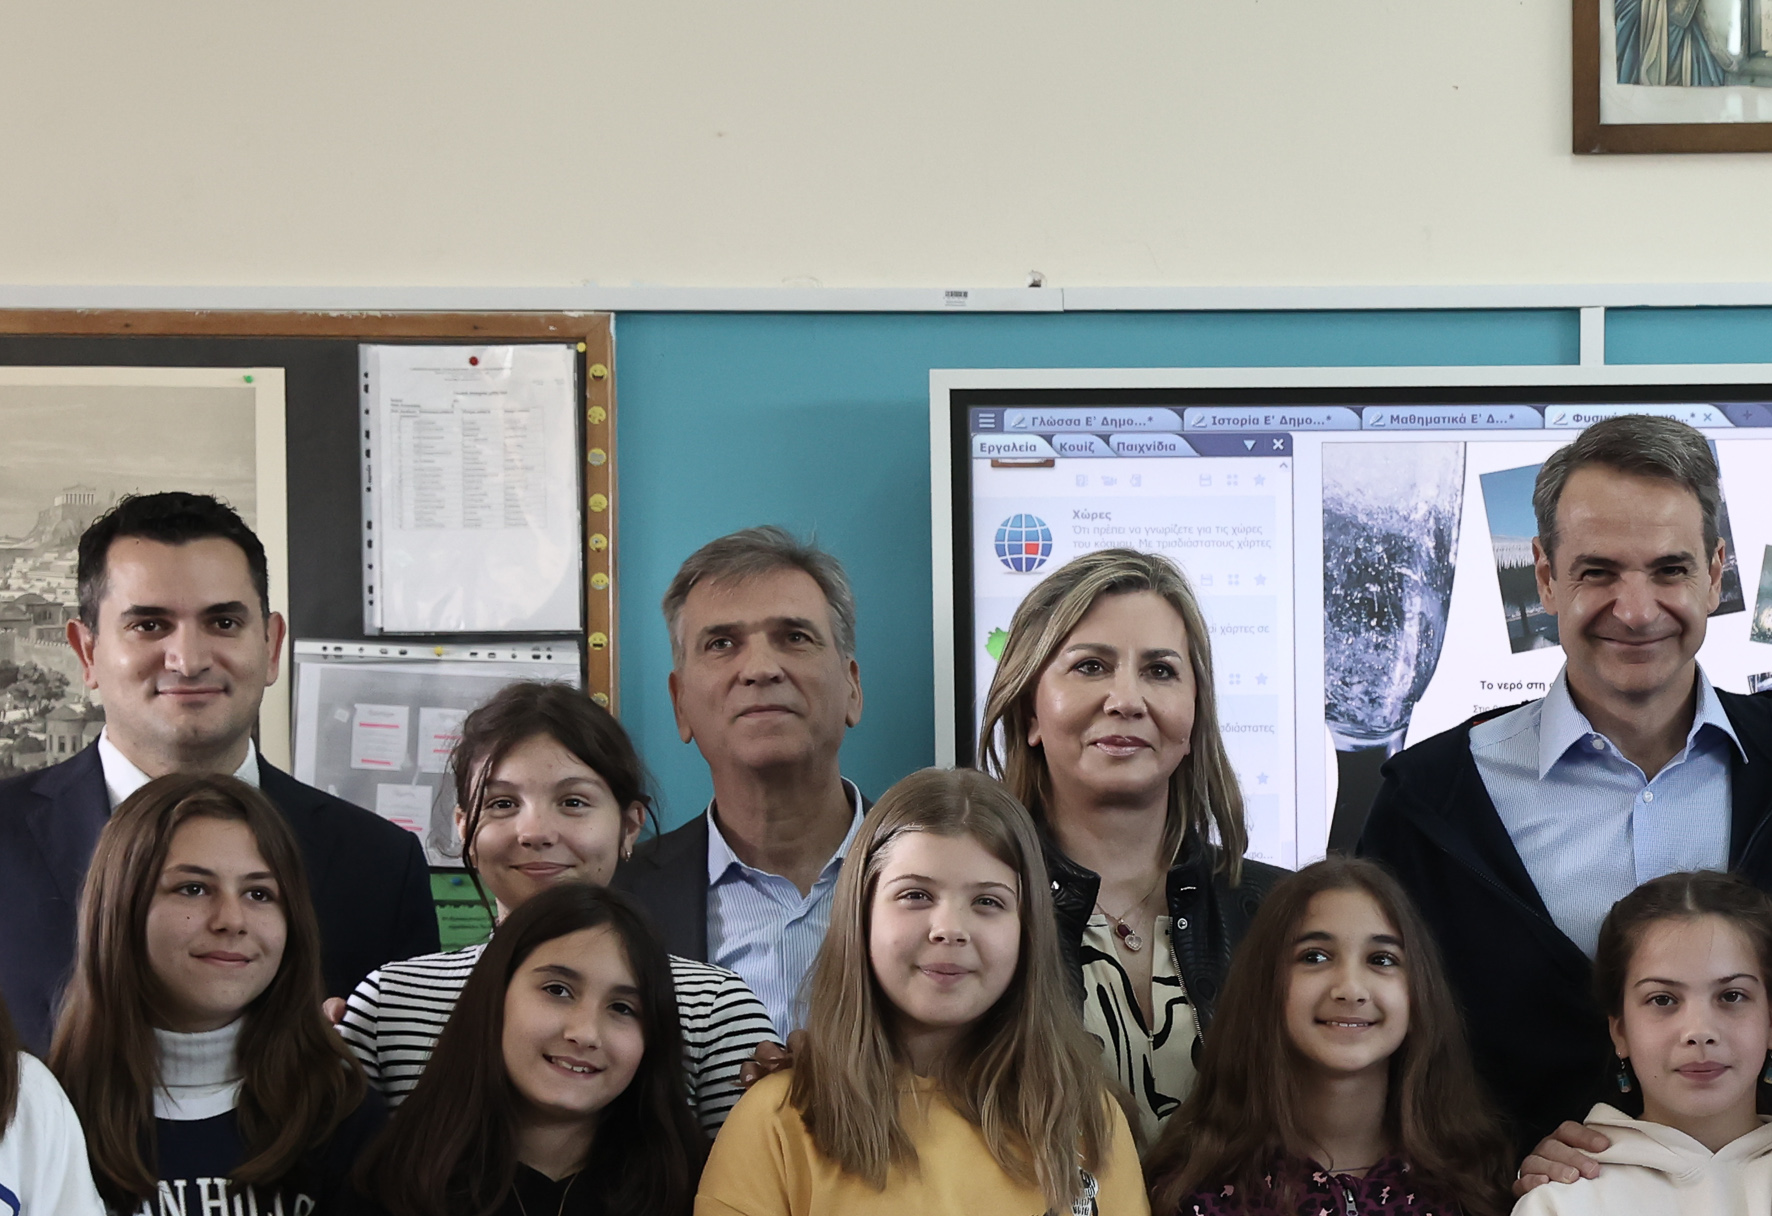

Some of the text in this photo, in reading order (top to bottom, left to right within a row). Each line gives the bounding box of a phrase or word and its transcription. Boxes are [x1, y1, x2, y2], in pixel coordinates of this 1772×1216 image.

[1031, 415, 1081, 427] Γλώσσα
[1211, 414, 1260, 428] Ιστορία
[1390, 413, 1467, 427] Μαθηματικά
[979, 441, 1176, 455] Εργαλεία Κουίζ Παιχνίδια
[1072, 508, 1112, 521] Χώρες
[1093, 525, 1126, 537] πρέπει
[1130, 526, 1142, 535] να
[1144, 524, 1194, 537] γνωρίζετε
[1196, 526, 1212, 536] για
[1215, 526, 1229, 536] τις
[1231, 524, 1263, 536] χώρες
[1072, 540, 1091, 549] του
[1138, 538, 1154, 548] Με
[1156, 538, 1235, 550] τρισδιάστατους
[1237, 537, 1272, 549] χάρτες
[1219, 623, 1255, 635] χάρτες
[1257, 625, 1270, 634] σε
[1480, 680, 1494, 690] Το
[1497, 680, 1523, 692] νερό
[1526, 681, 1546, 692] στη
